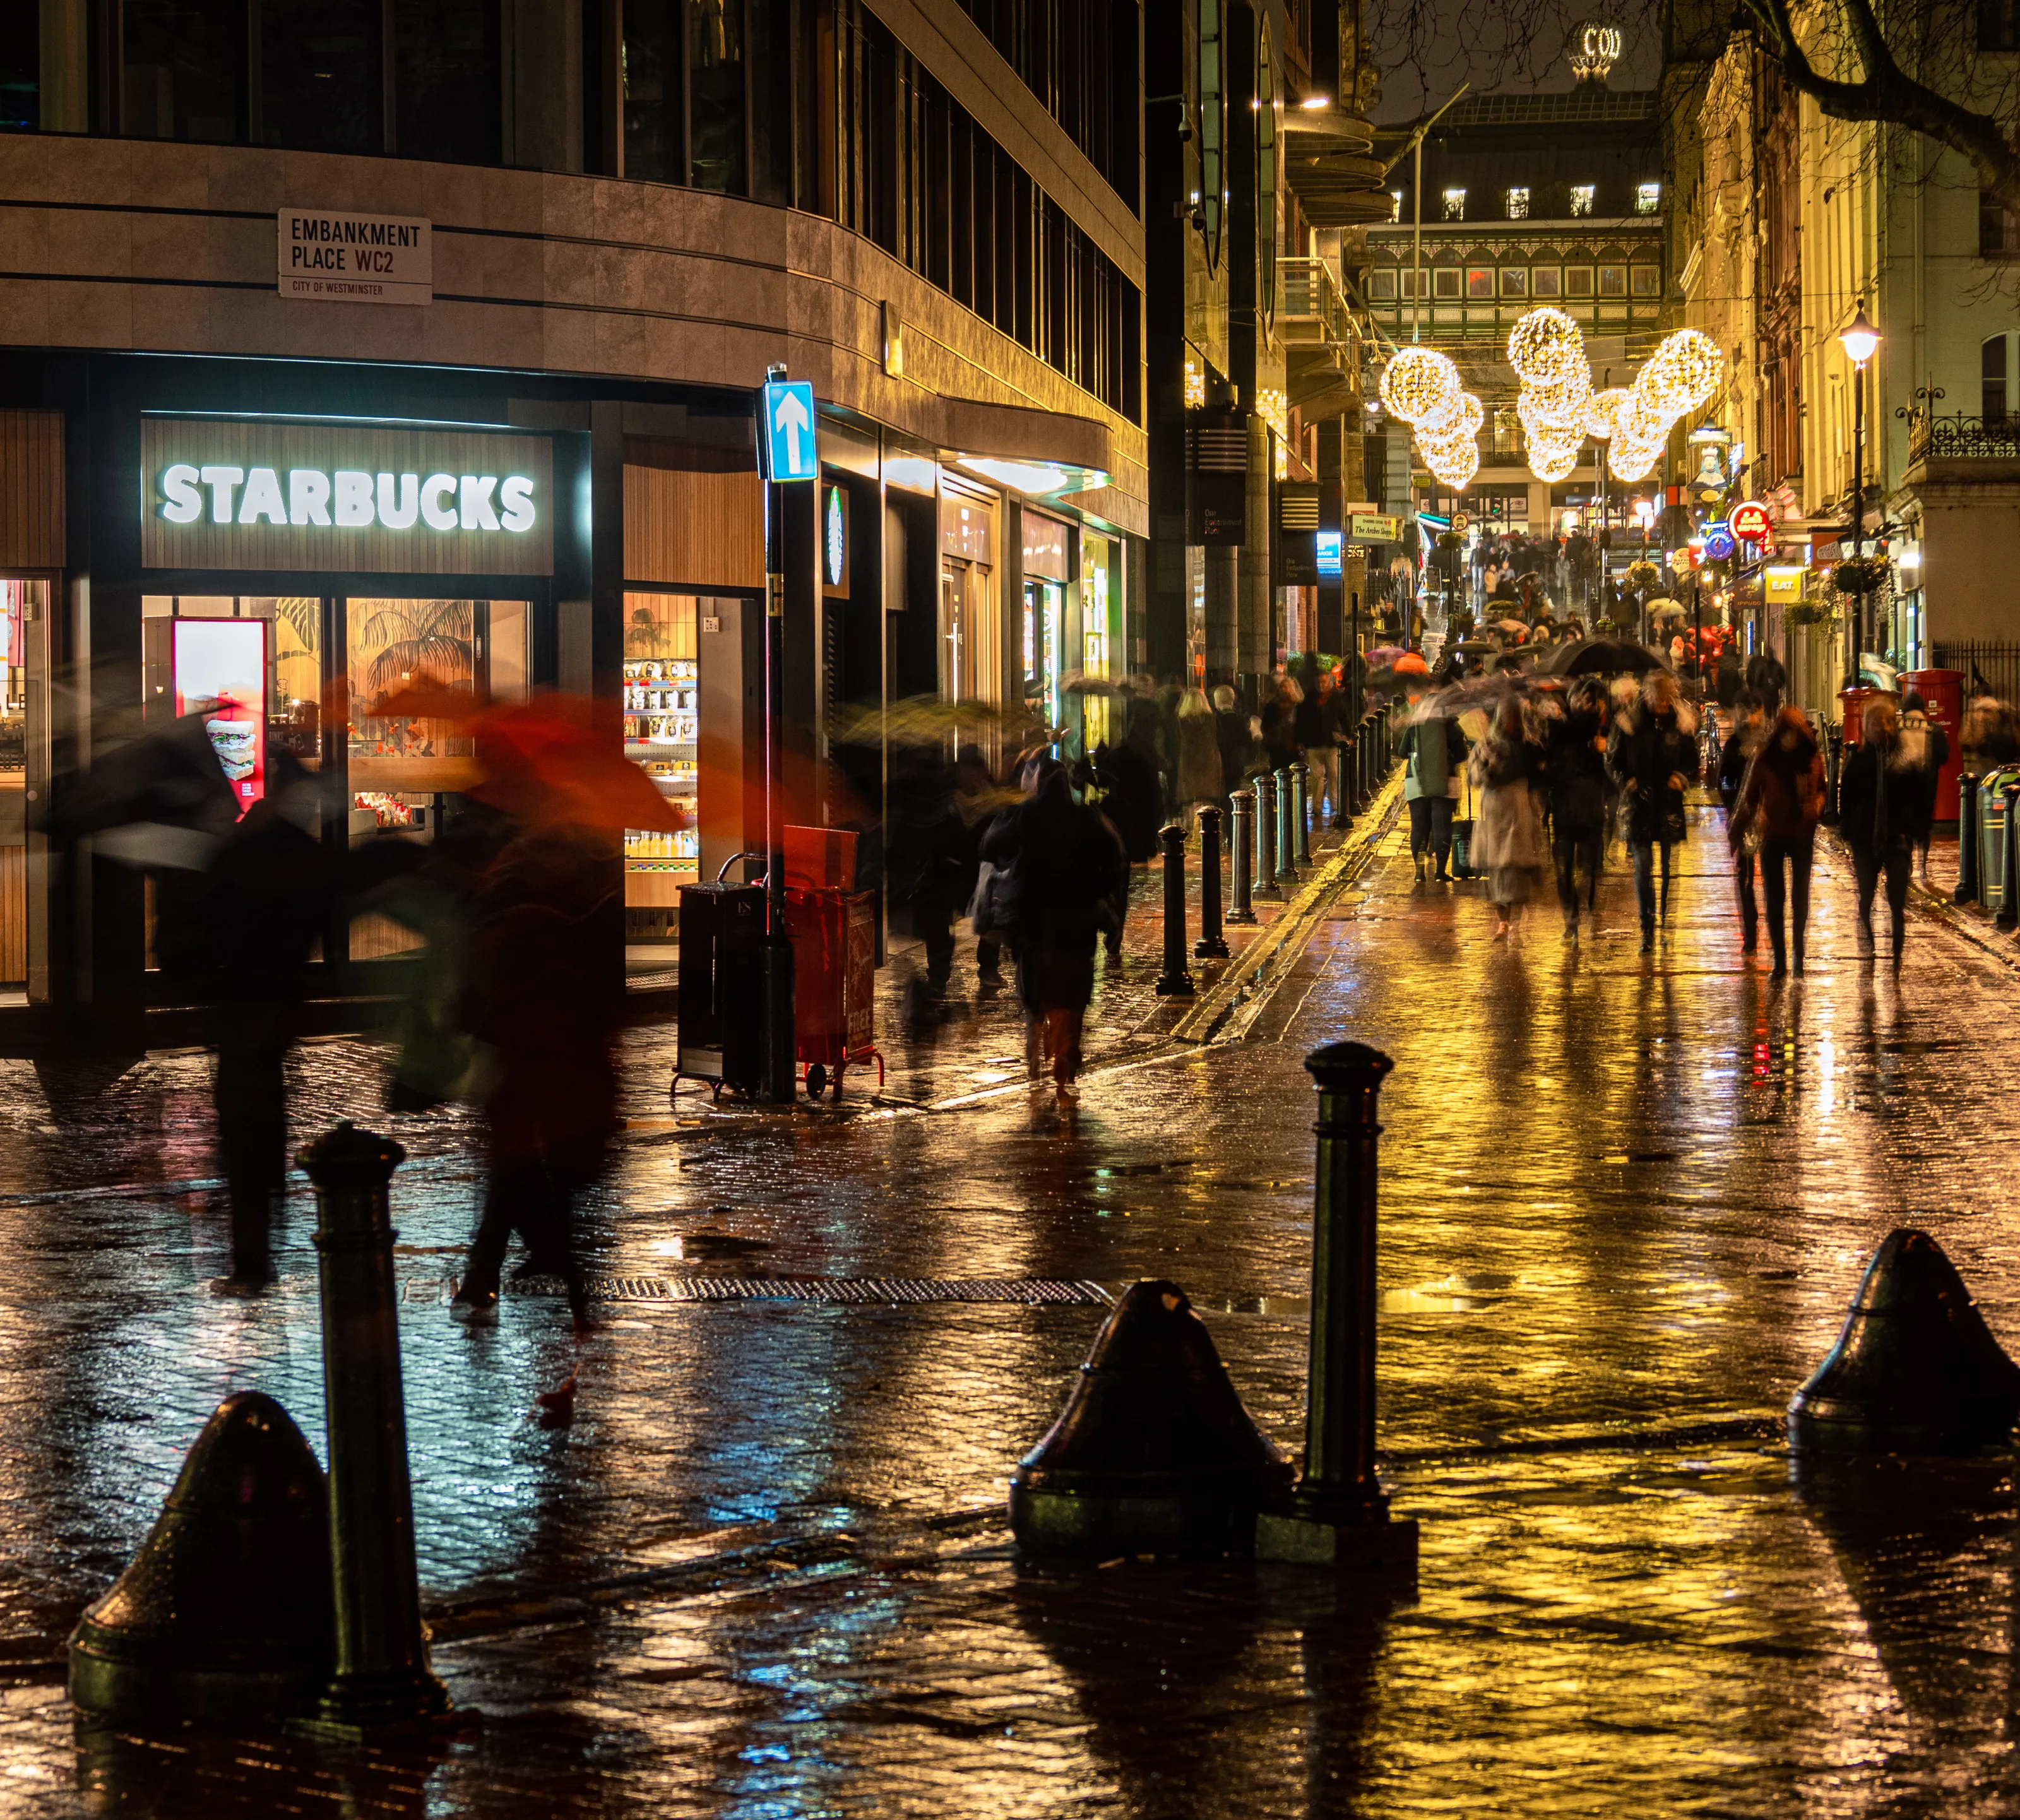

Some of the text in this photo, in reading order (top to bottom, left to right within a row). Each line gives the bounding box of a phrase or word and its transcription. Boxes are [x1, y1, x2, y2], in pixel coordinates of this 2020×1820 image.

[292, 218, 420, 247] EMBANKMENT
[292, 246, 393, 273] PLACE WC2
[292, 280, 383, 295] CITY OF WESTMINSTER
[162, 465, 535, 532] STARBUCKS
[1204, 508, 1217, 516] One
[1365, 526, 1380, 535] Arches
[1819, 543, 1836, 552] WRAP
[1771, 581, 1795, 590] EAT.
[848, 1008, 872, 1033] FREE
